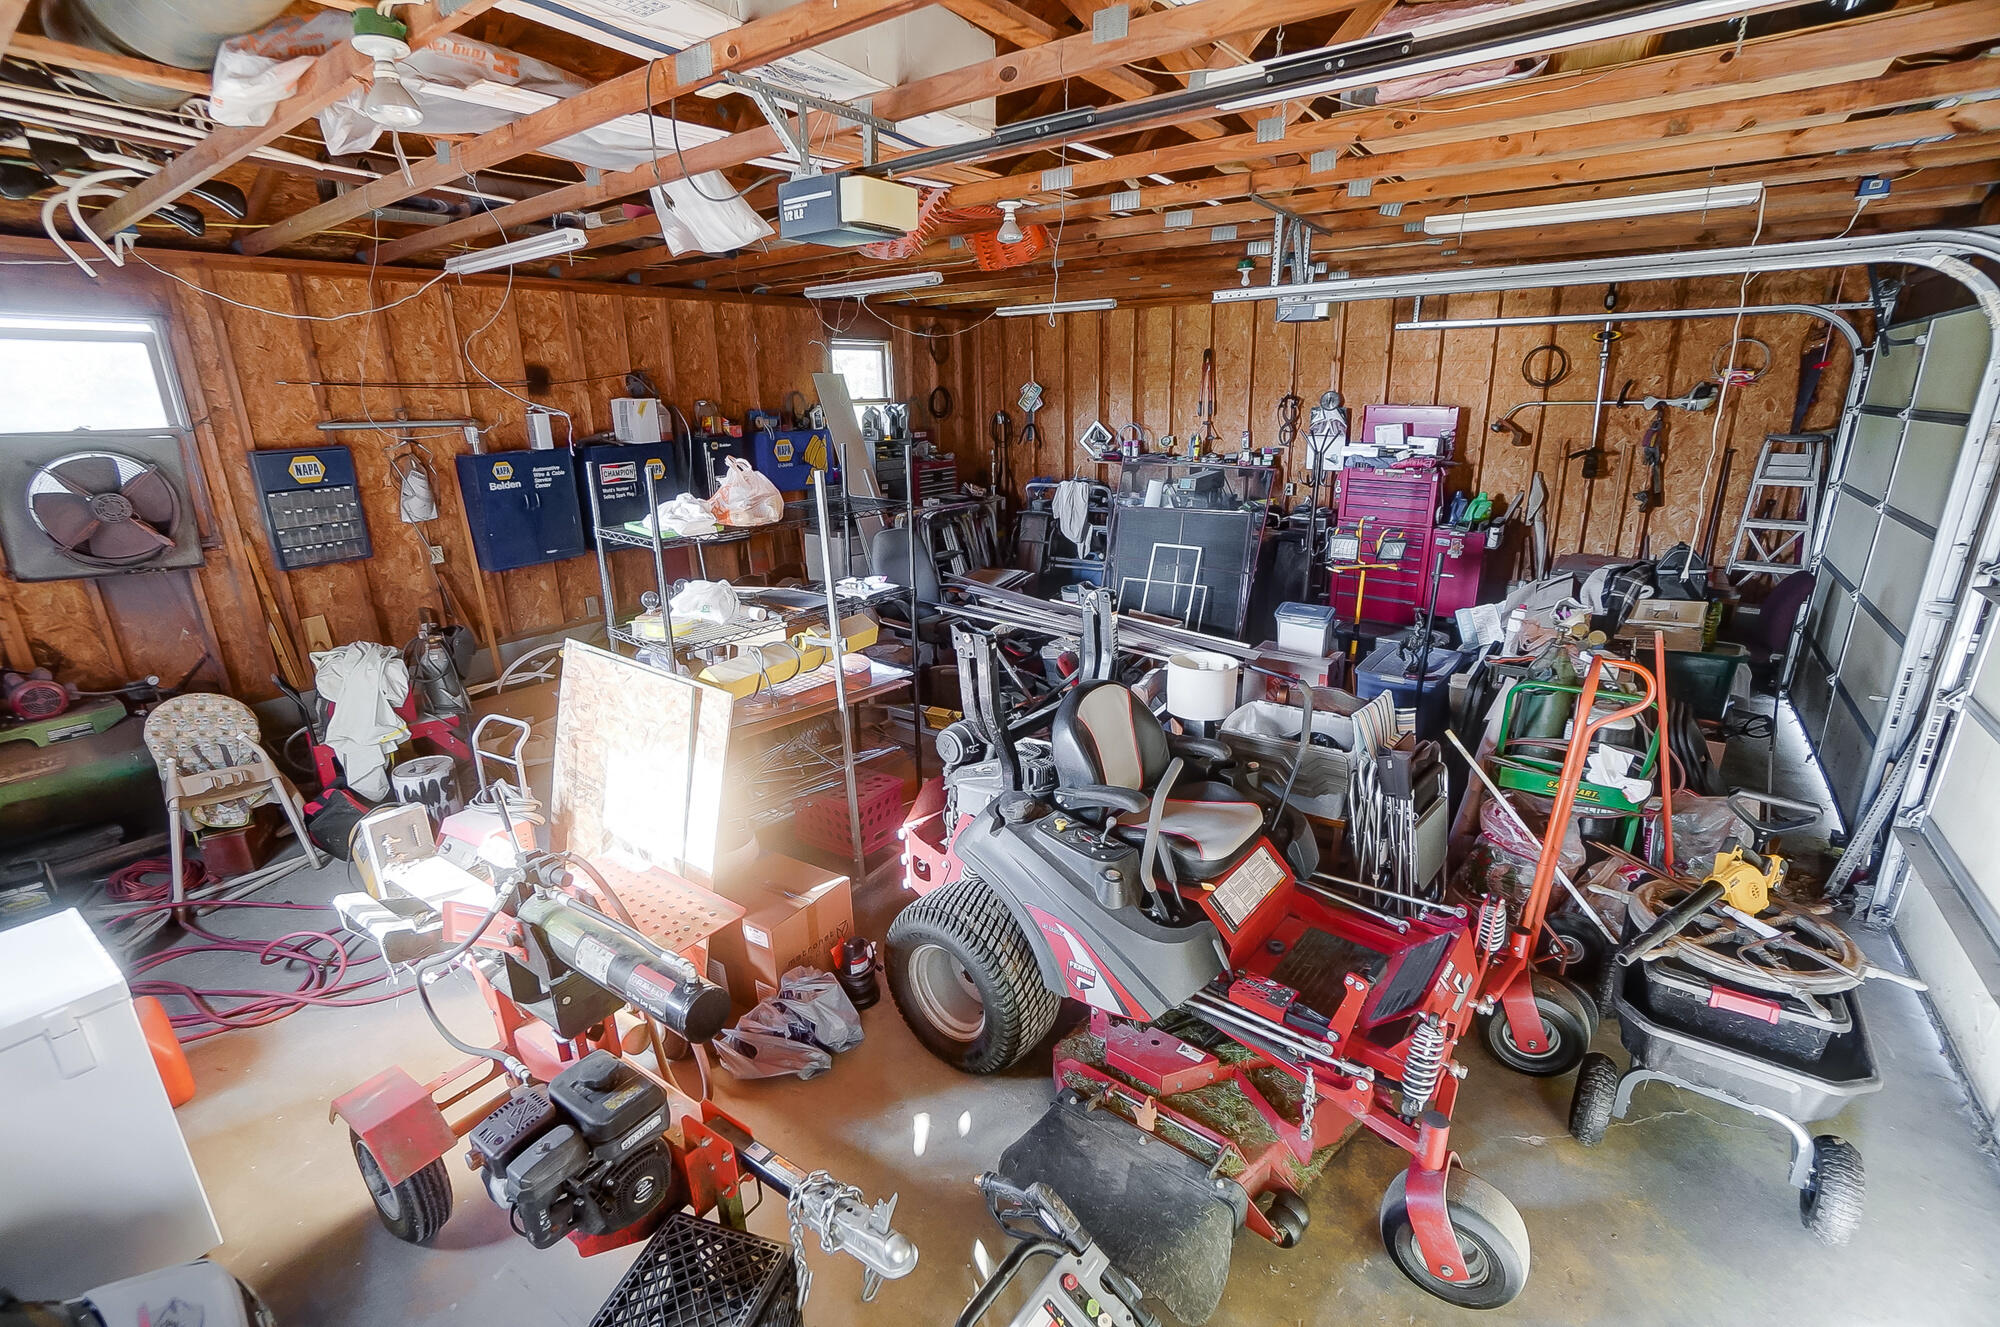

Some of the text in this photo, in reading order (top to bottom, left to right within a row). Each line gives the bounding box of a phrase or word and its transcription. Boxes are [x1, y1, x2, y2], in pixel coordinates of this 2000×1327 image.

[777, 444, 791, 457] NAPA
[294, 463, 321, 477] NAPA
[495, 466, 511, 476] NAPA
[532, 465, 560, 473] Automotive
[603, 468, 634, 478] CHAMPION
[489, 481, 521, 491] Belden
[1070, 961, 1096, 977] FERRIS
